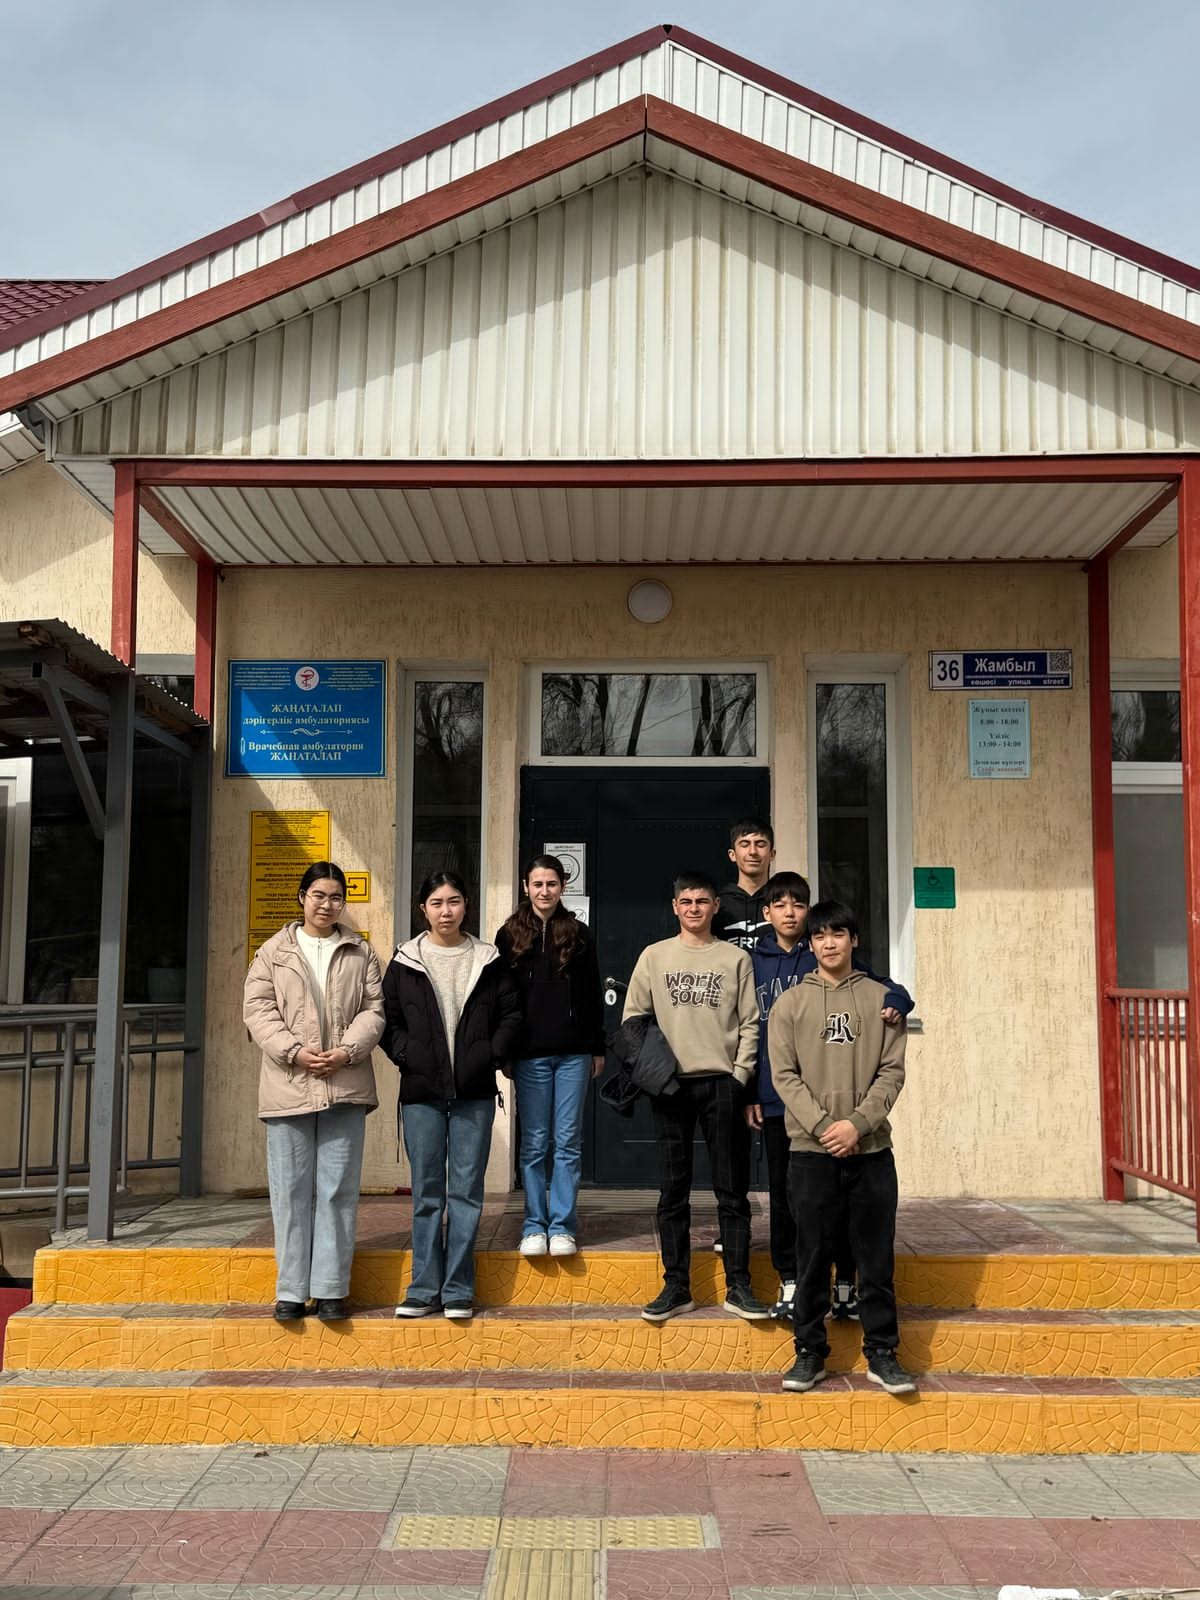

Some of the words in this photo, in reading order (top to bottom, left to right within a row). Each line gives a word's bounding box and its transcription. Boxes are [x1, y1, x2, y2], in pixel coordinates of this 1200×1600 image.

[937, 660, 960, 681] 36
[975, 658, 1036, 673] Жамбыл
[242, 715, 293, 727] дәрігерлік
[295, 715, 369, 727] амбулаториясы
[248, 741, 300, 753] Врачебная
[302, 741, 364, 753] амбулатория
